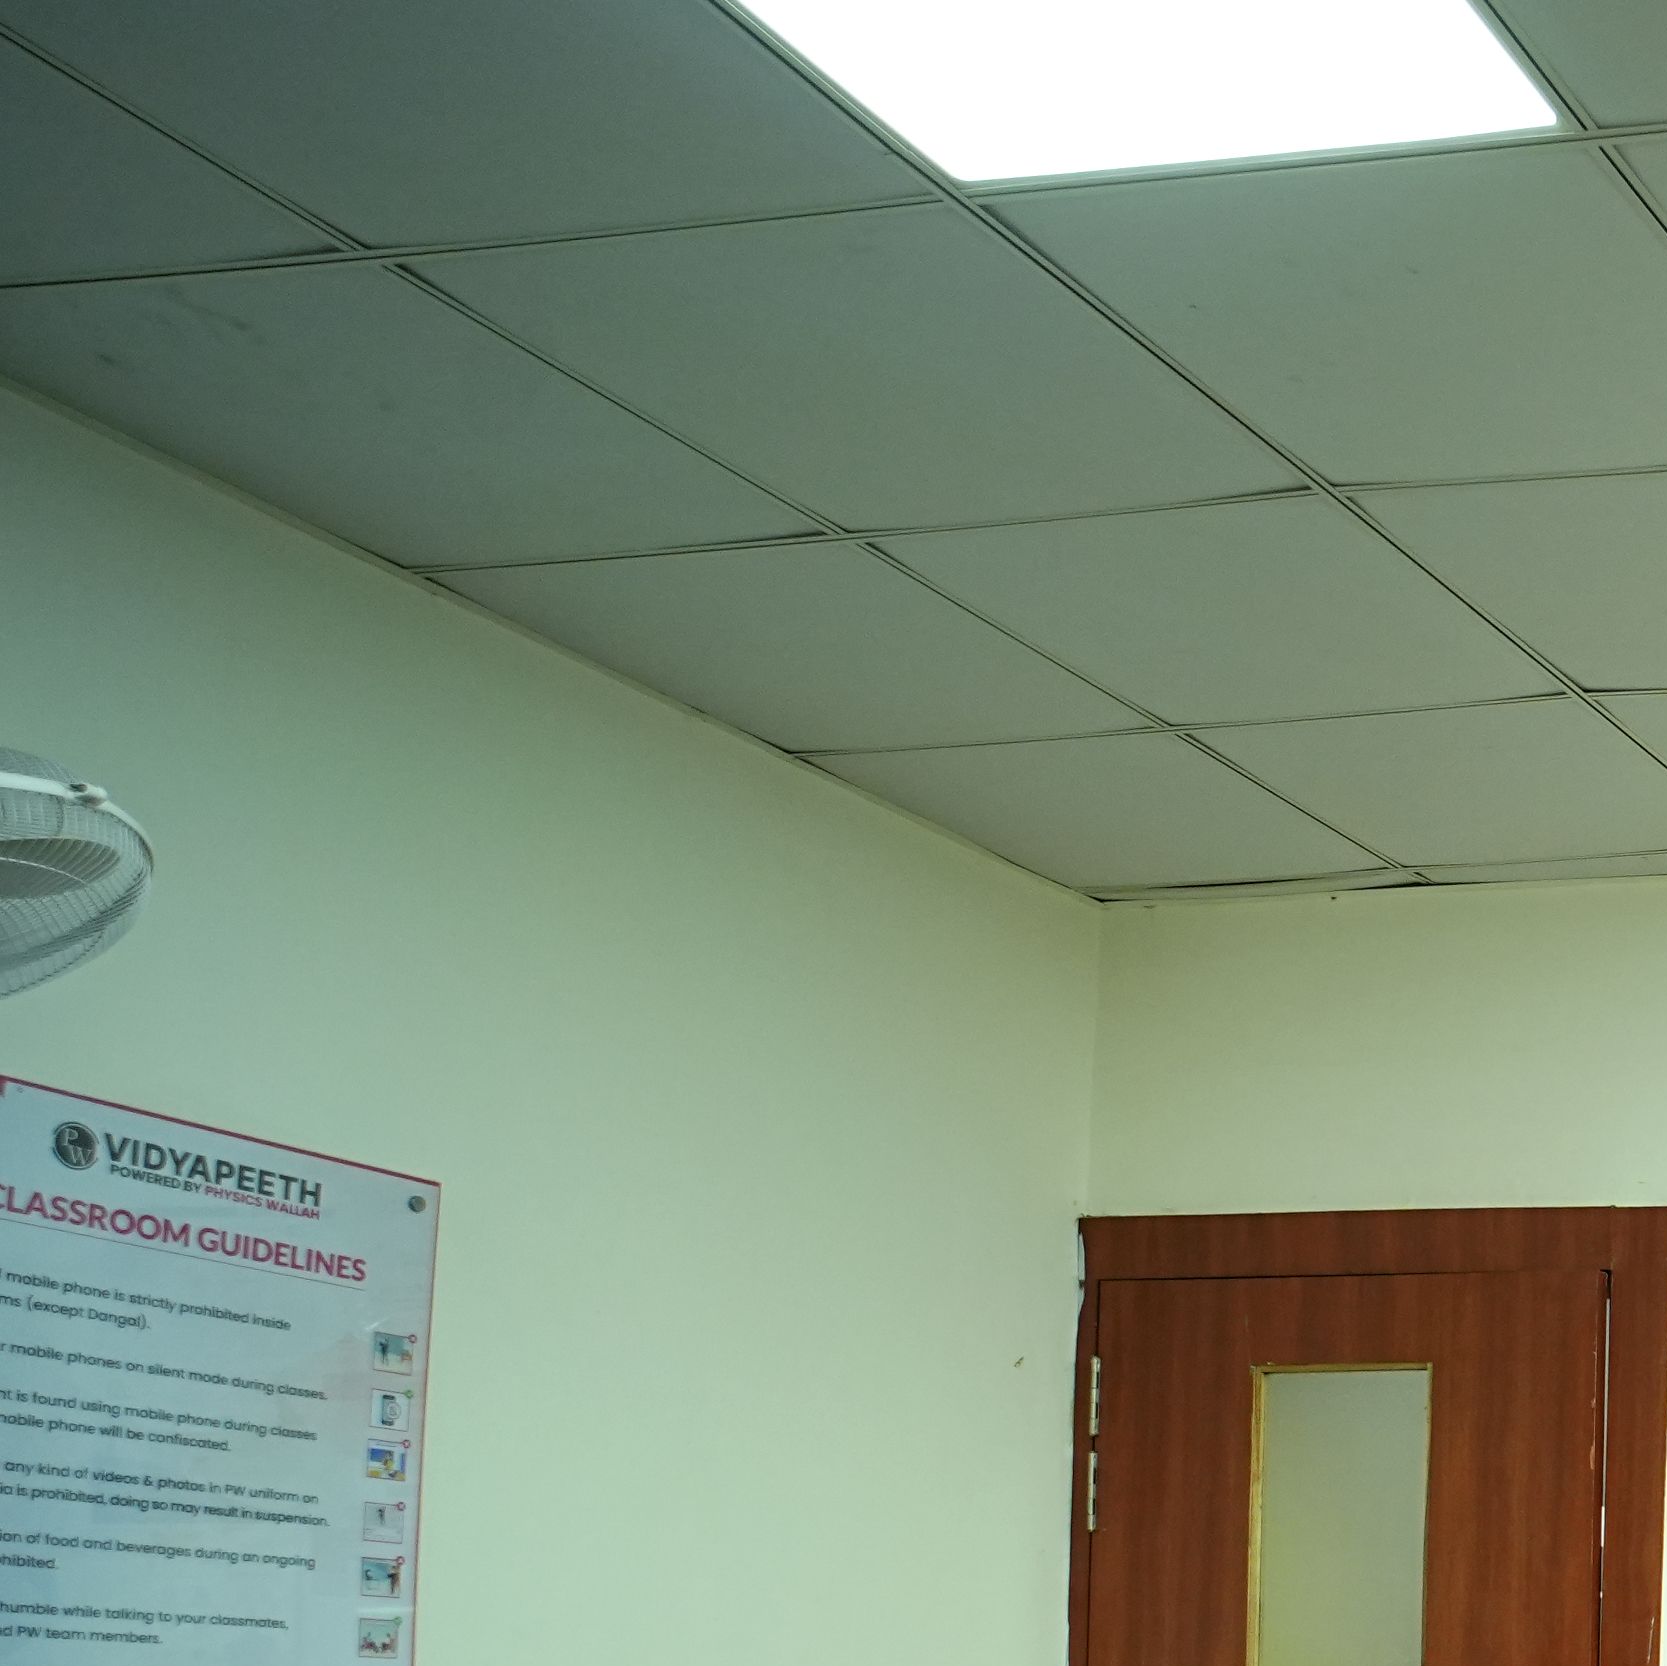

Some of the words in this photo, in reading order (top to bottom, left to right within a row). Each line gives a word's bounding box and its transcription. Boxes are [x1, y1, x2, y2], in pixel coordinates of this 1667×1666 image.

[104, 1132, 322, 1208] VIDYAPEETH
[110, 1165, 181, 1190] POWERED
[182, 1178, 202, 1193] BY
[204, 1185, 262, 1207] PHYSICS
[266, 1198, 320, 1220] WALLAH
[0, 1185, 191, 1247] LASSROOM
[198, 1227, 366, 1282] GUIDELINES
[6, 1271, 59, 1290] mobile
[63, 1282, 110, 1300] phone
[114, 1289, 126, 1302] is
[129, 1292, 176, 1314] strictly
[179, 1301, 249, 1324] prohibited
[252, 1313, 291, 1331] inside
[28, 1295, 84, 1319] (except
[11, 1342, 63, 1361] mobile
[67, 1352, 122, 1371] phones
[126, 1361, 144, 1374] on
[148, 1363, 185, 1380] silent
[189, 1370, 229, 1386] mode
[232, 1376, 274, 1396] during
[278, 1383, 328, 1401] classes.
[5, 1460, 33, 1476] any
[38, 1463, 70, 1478] kind
[75, 1467, 89, 1479] of
[93, 1471, 139, 1486] videos
[144, 1475, 153, 1486] &
[158, 1477, 206, 1493] photos
[209, 1482, 221, 1494] in
[224, 1484, 246, 1497] PW
[249, 1486, 300, 1503] uniform
